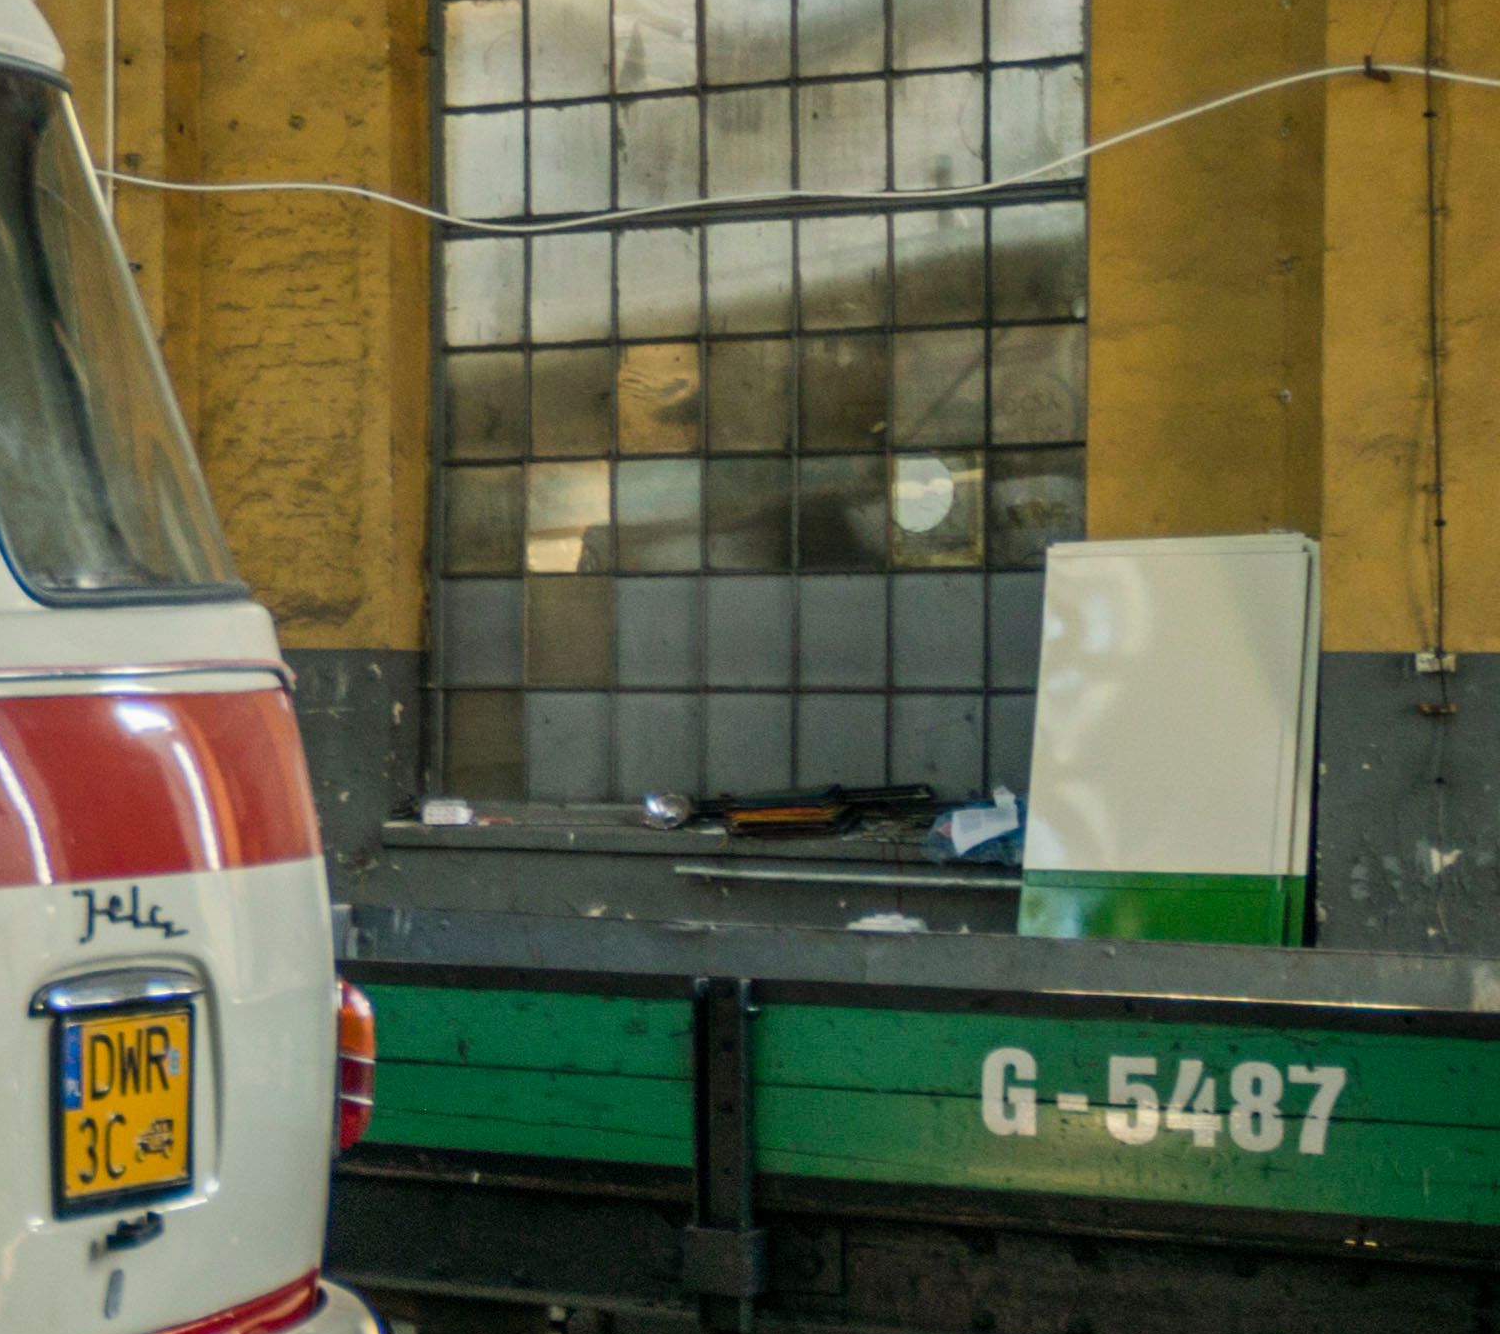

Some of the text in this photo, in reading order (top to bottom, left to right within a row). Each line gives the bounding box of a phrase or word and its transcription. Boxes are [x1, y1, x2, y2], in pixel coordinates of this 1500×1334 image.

[89, 1025, 171, 1101] DWR
[980, 1046, 1347, 1156] G-5487
[78, 1112, 127, 1184] 3C
